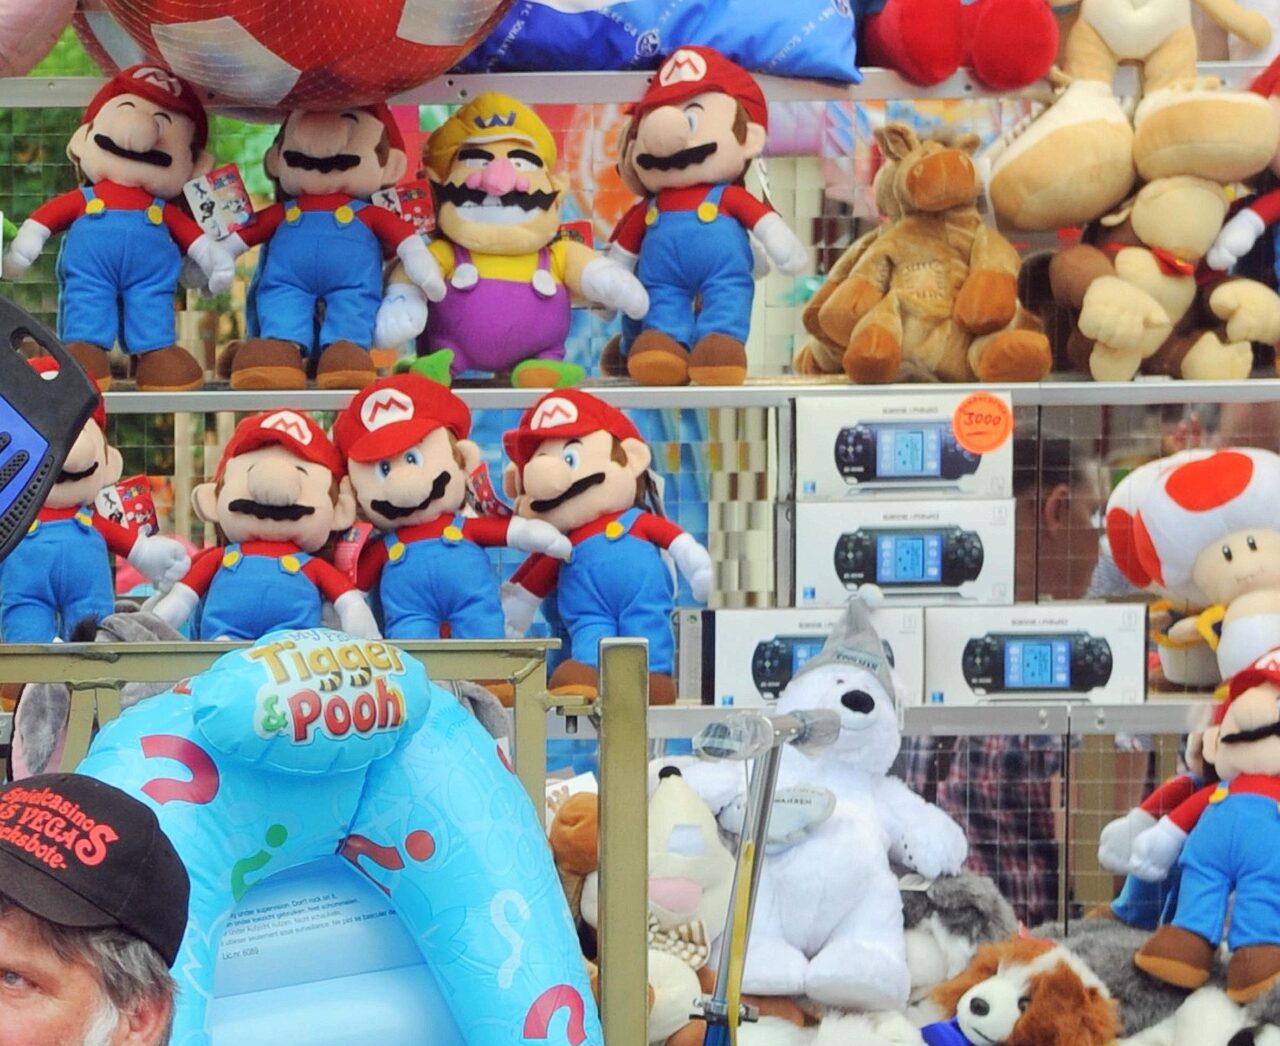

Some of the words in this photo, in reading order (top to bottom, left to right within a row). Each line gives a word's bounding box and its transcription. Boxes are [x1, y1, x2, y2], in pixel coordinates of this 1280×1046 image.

[251, 639, 404, 692] Tigger
[288, 674, 404, 743] Pooh
[19, 805, 120, 866] VEGAS
